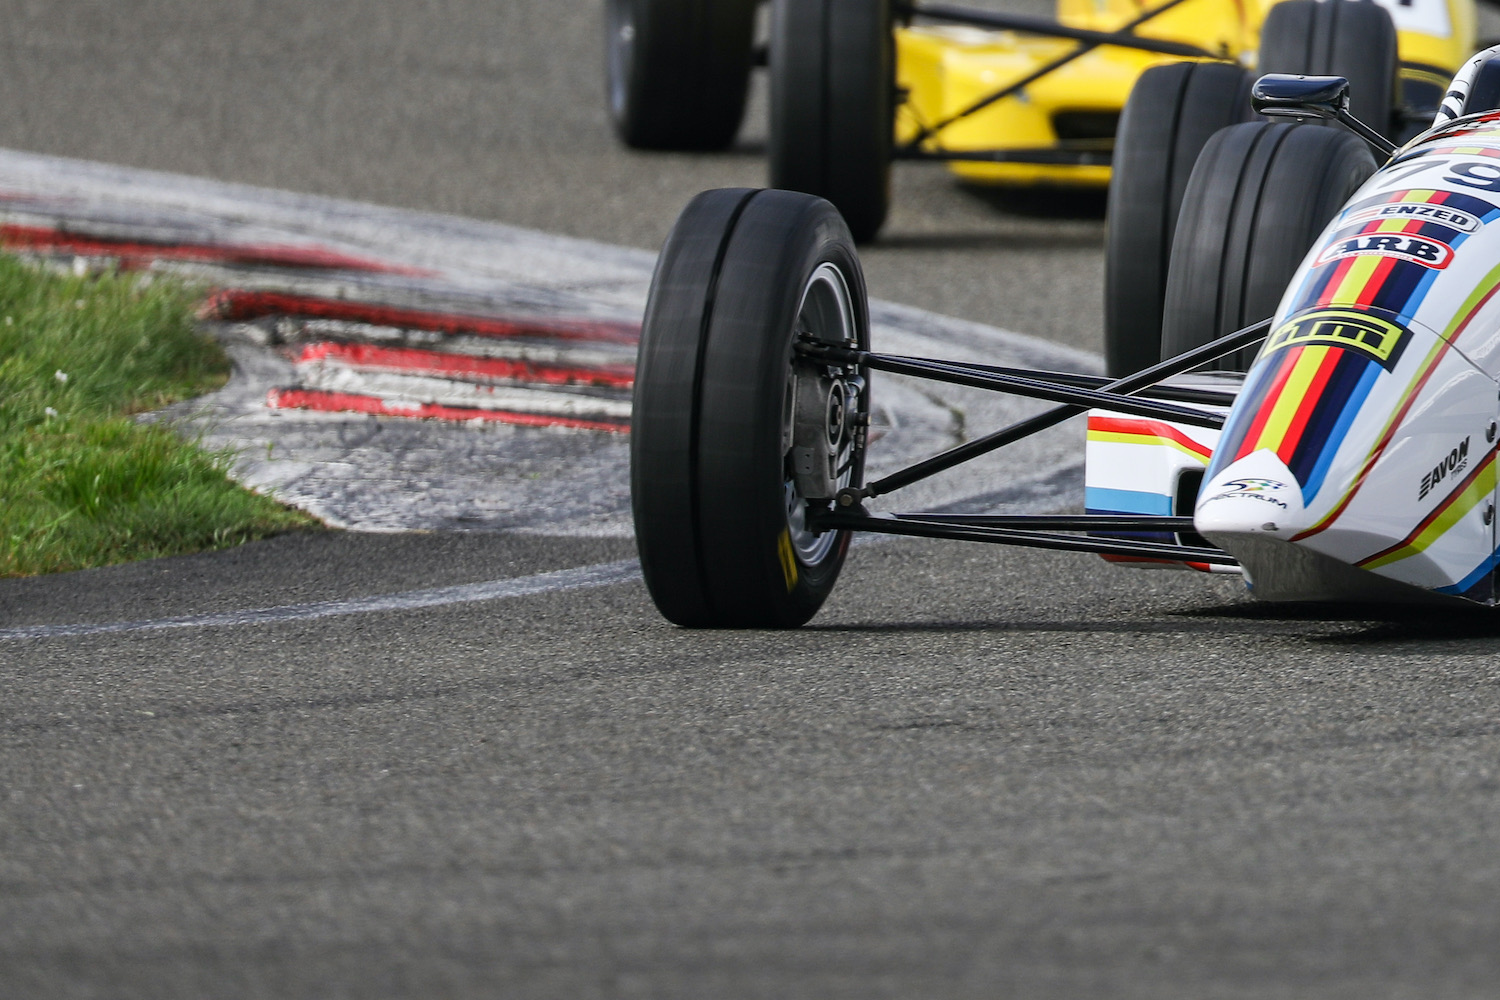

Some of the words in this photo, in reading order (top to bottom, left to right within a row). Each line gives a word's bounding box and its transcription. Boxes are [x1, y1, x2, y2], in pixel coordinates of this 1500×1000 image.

[1380, 206, 1468, 226] ENZED
[1327, 236, 1440, 261] ARB
[1429, 434, 1471, 490] AVON
